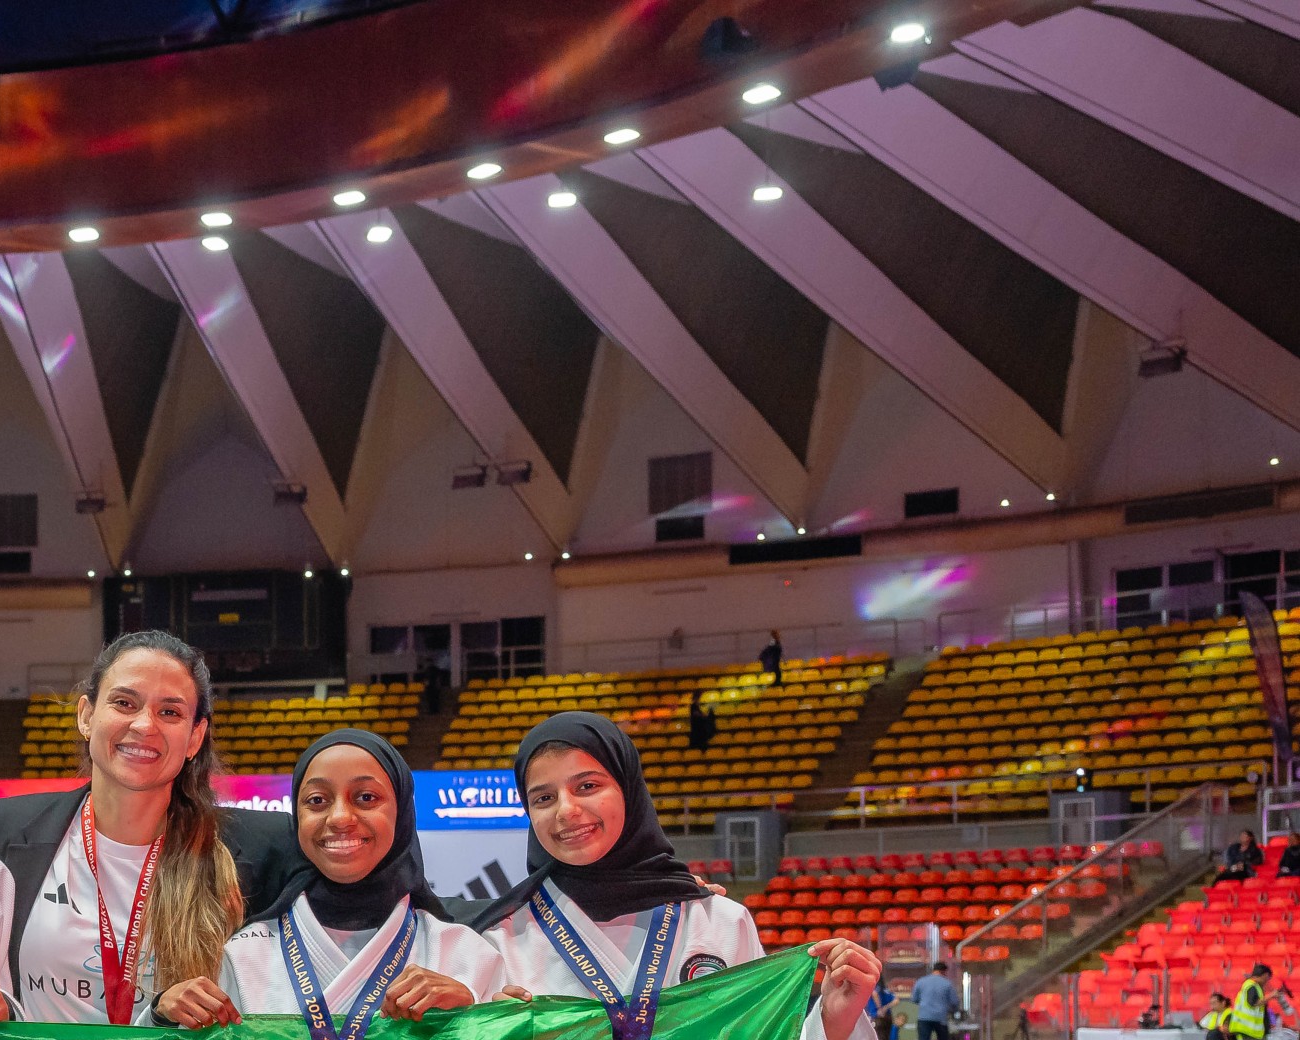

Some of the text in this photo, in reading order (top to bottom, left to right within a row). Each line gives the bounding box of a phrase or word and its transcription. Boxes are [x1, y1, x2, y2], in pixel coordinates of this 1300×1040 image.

[123, 940, 137, 982] JUJITSU
[130, 900, 144, 937] WORLD
[553, 925, 597, 977] THAILAND
[591, 978, 618, 1005] 2025
[287, 939, 314, 995] THAILAND
[305, 996, 326, 1029] 2025
[364, 975, 388, 1003] World
[636, 977, 655, 1023] Ju-Jitsu
[647, 944, 664, 974] World
